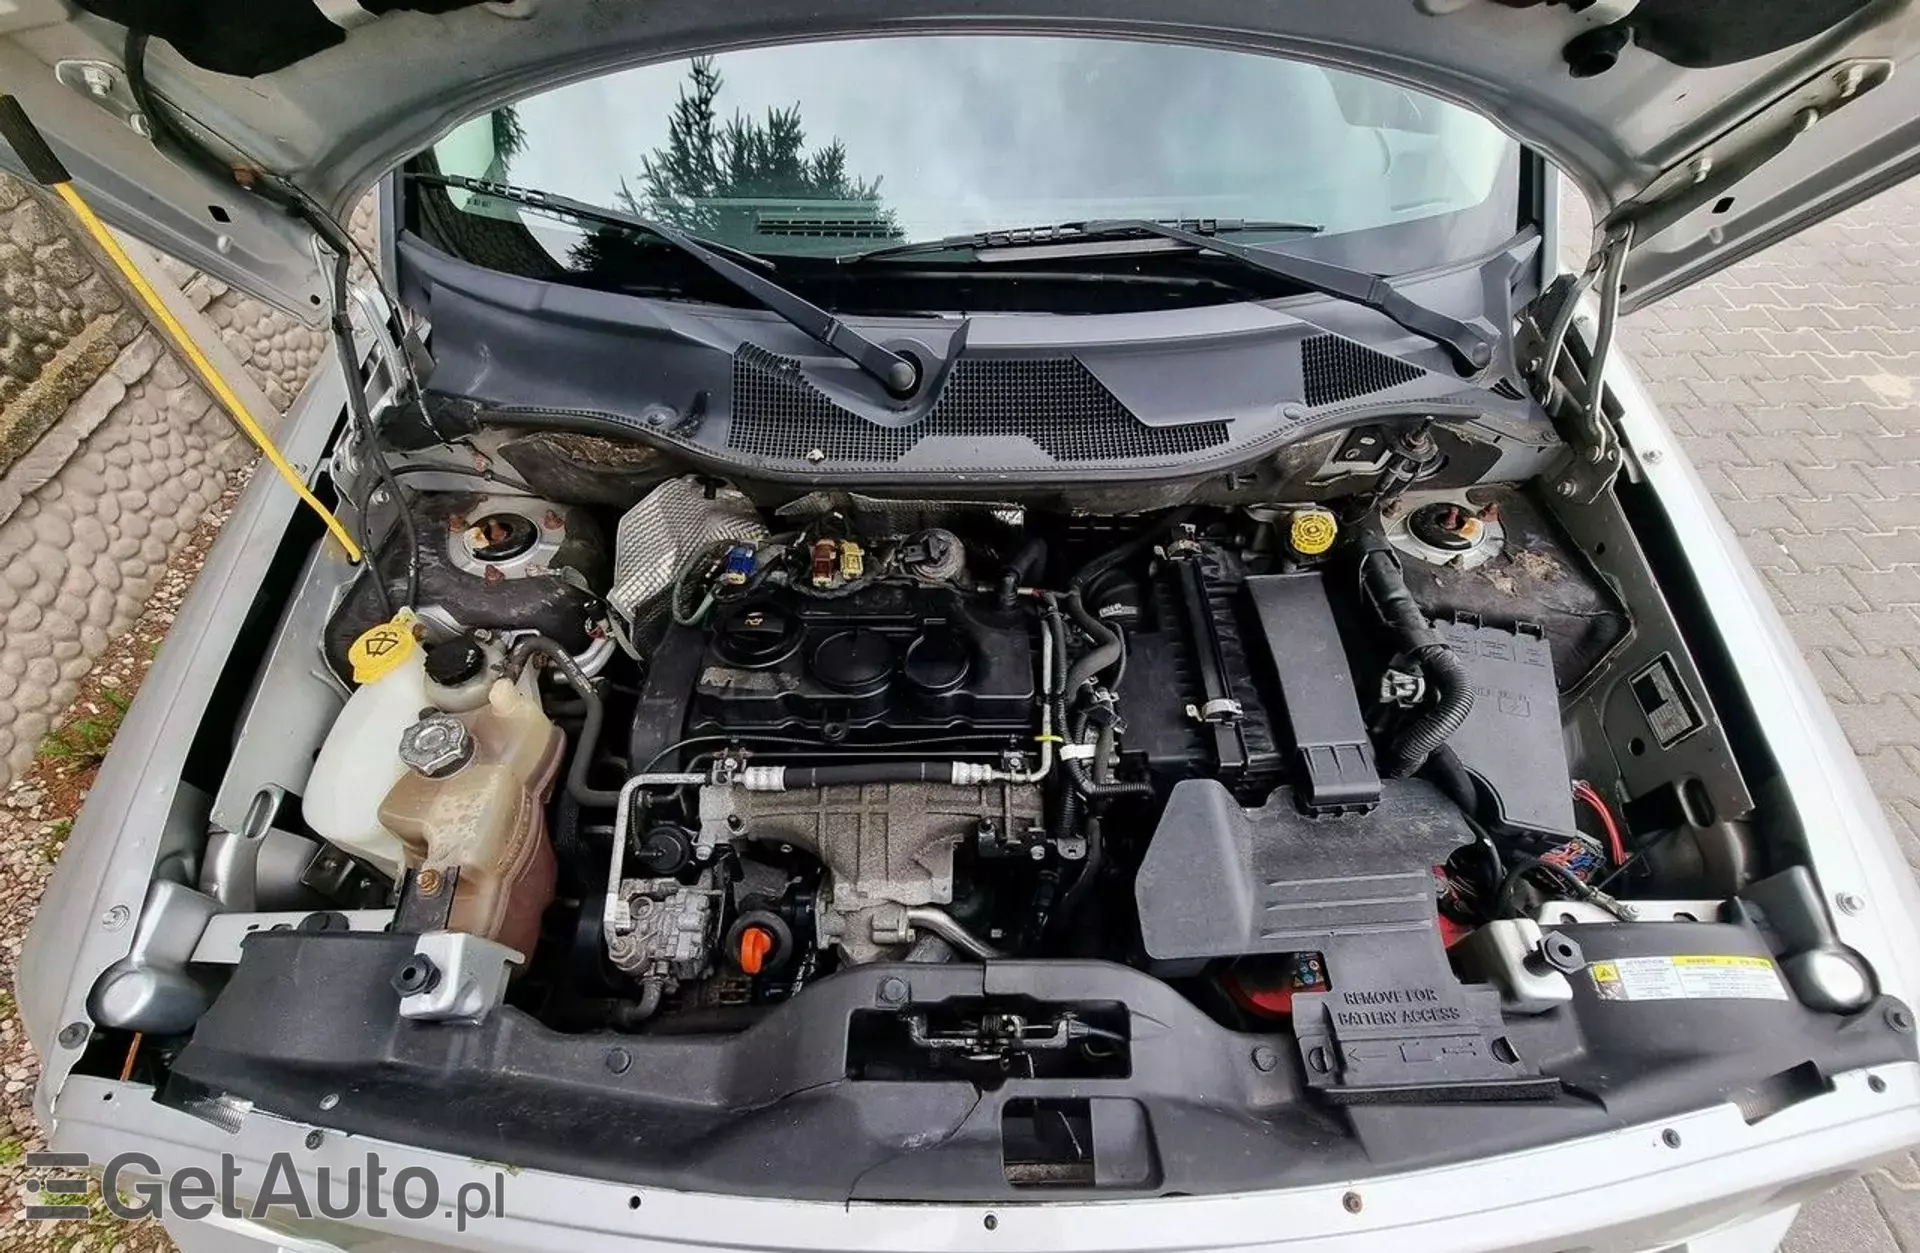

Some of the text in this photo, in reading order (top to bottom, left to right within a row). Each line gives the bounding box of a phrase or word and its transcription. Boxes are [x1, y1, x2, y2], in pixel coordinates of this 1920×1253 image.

[1343, 988, 1438, 1005] REMOVE FOR
[1336, 1007, 1461, 1025] BATTERY ACCESS
